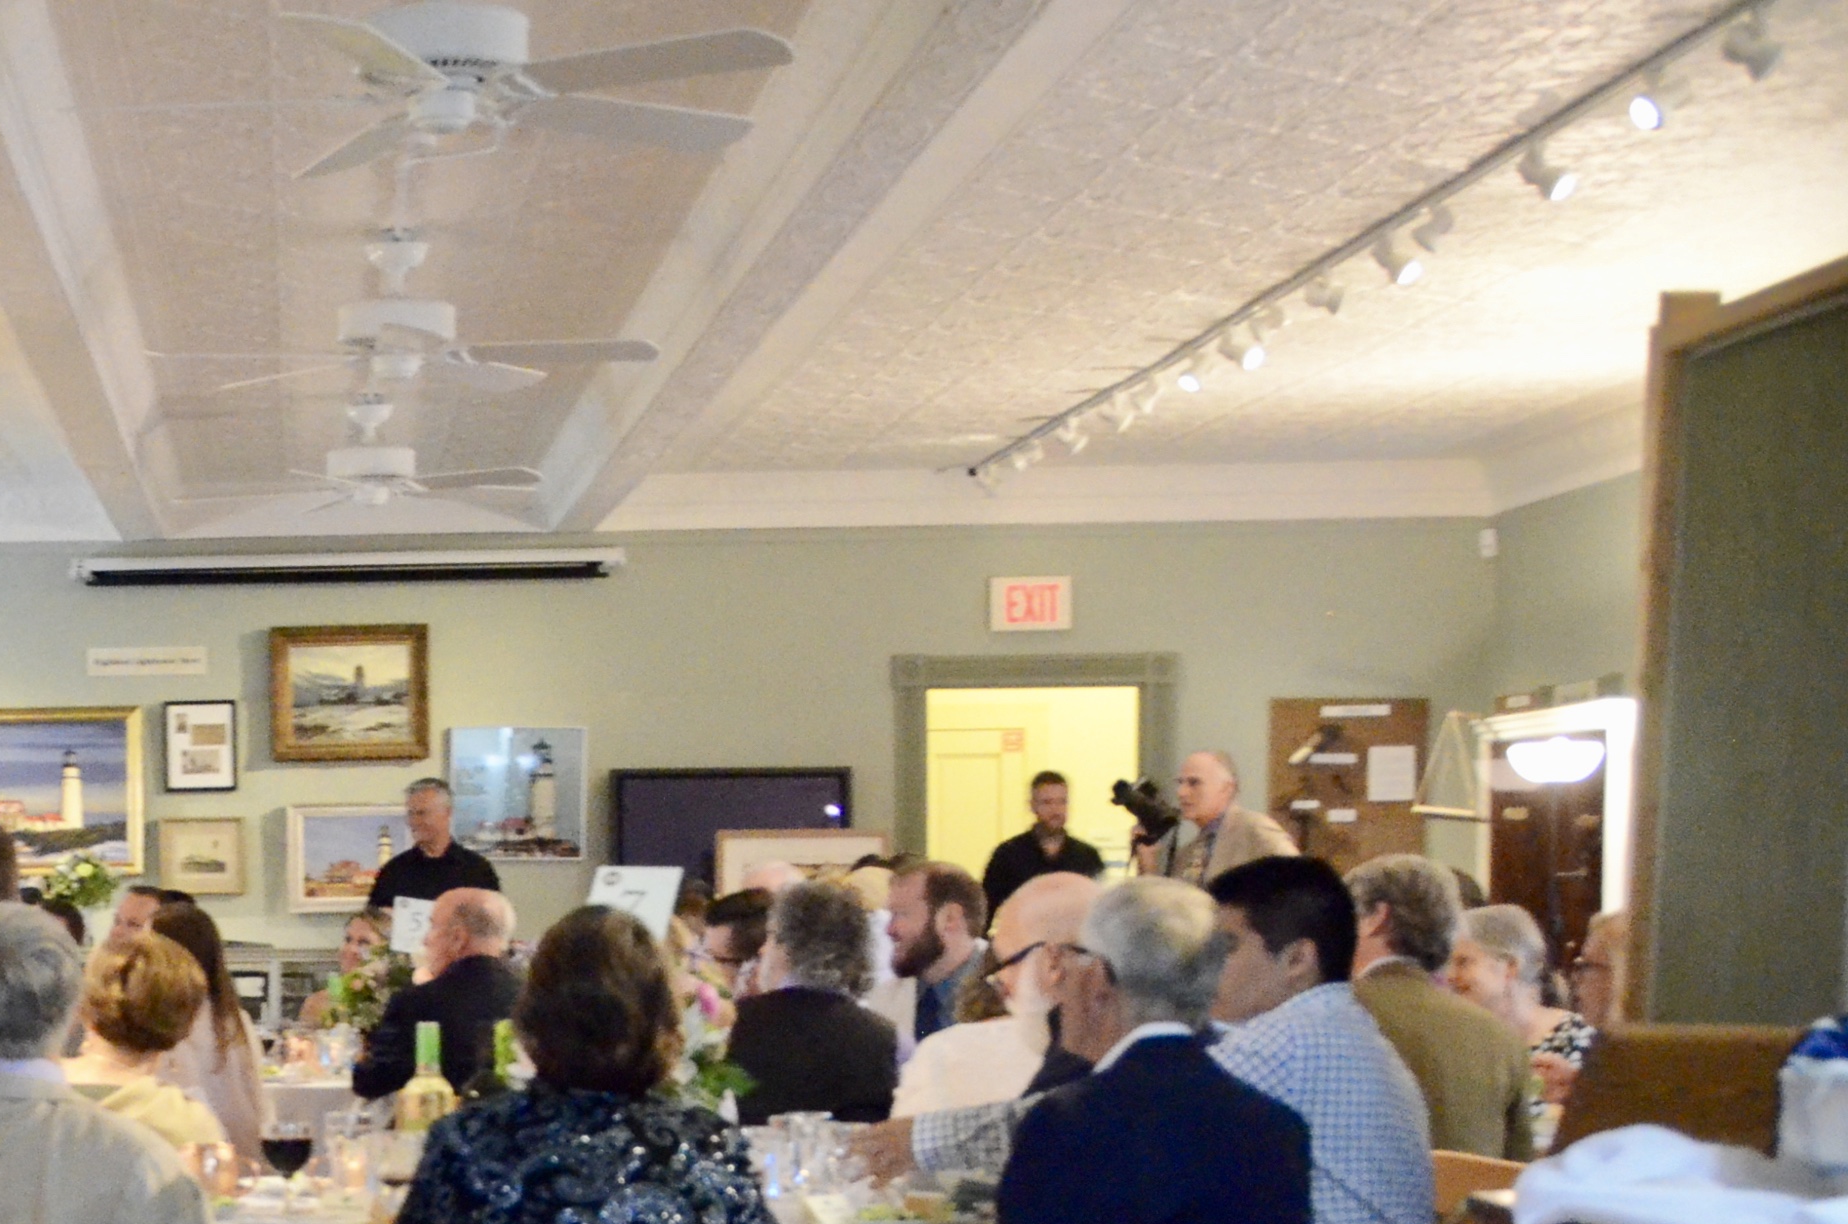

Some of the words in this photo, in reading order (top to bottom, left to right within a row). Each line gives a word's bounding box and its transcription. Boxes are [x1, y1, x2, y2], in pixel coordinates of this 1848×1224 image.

[1005, 583, 1060, 623] EXIT
[620, 888, 648, 912] 7
[409, 911, 423, 932] 5
